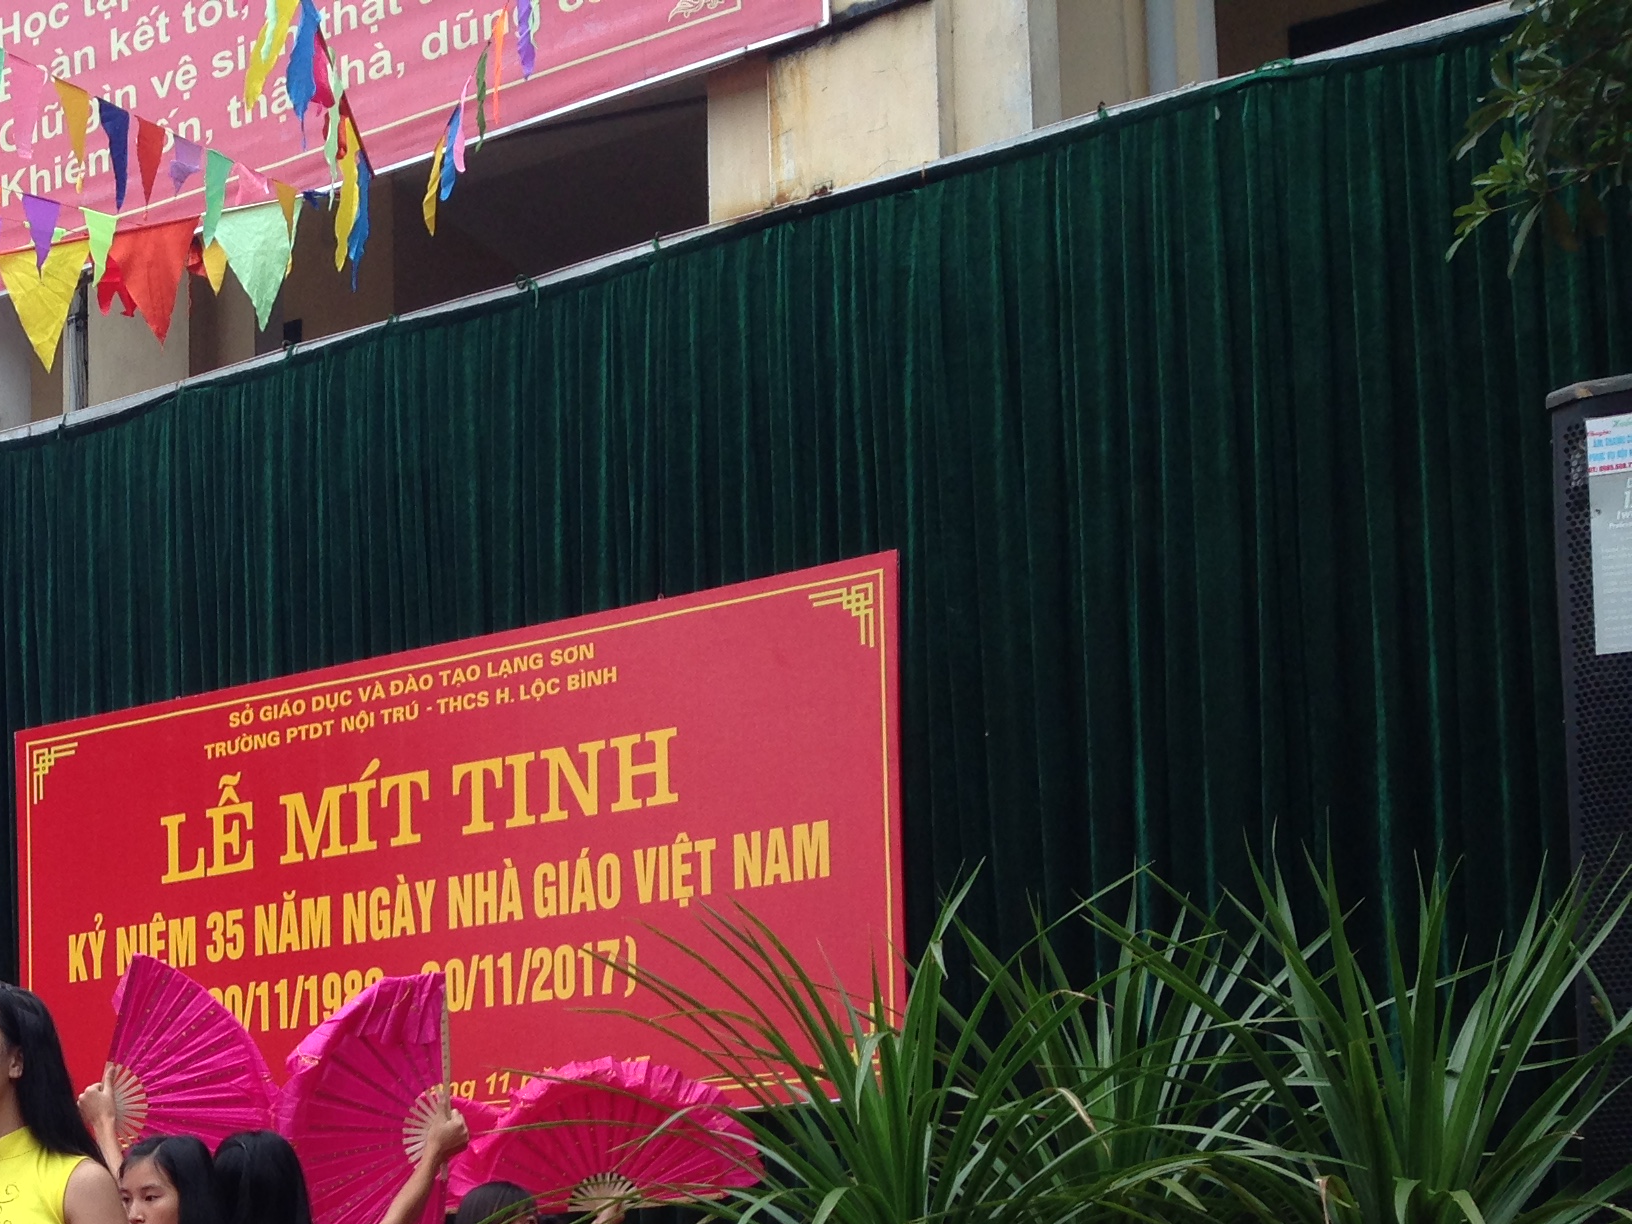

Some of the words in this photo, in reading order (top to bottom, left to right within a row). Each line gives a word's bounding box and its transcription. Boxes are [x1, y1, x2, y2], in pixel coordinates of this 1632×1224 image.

[110, 5, 171, 62] kết
[150, 55, 198, 101] vệ
[204, 731, 280, 760] TRƯỜNG
[286, 720, 334, 743] PTDT
[341, 710, 375, 733] NỘI
[381, 701, 419, 725] TRÚ
[437, 691, 489, 714] THCS
[496, 687, 515, 705] H.
[520, 678, 560, 701] LỘC
[568, 666, 617, 691] BÌNH
[229, 704, 254, 728] SỞ
[260, 699, 306, 722] GIÁO
[312, 690, 353, 713] DỤC
[358, 681, 386, 702] VÀ
[390, 673, 434, 696] ĐÀO
[439, 664, 481, 687] TẠO
[487, 652, 544, 678] LẠNG
[550, 643, 595, 666] SƠN
[161, 771, 254, 884] LỄ
[279, 758, 430, 864] MÍT
[452, 726, 679, 835] TINH
[68, 912, 106, 983] KỶ
[206, 909, 245, 963] 35
[255, 890, 331, 956] NĂM
[343, 874, 436, 945] NGÀY
[448, 857, 524, 930] NHÀ
[534, 847, 621, 919] GIÁO
[633, 832, 717, 908] VIỆT
[733, 820, 830, 890] NAM
[485, 1072, 510, 1095] 11
